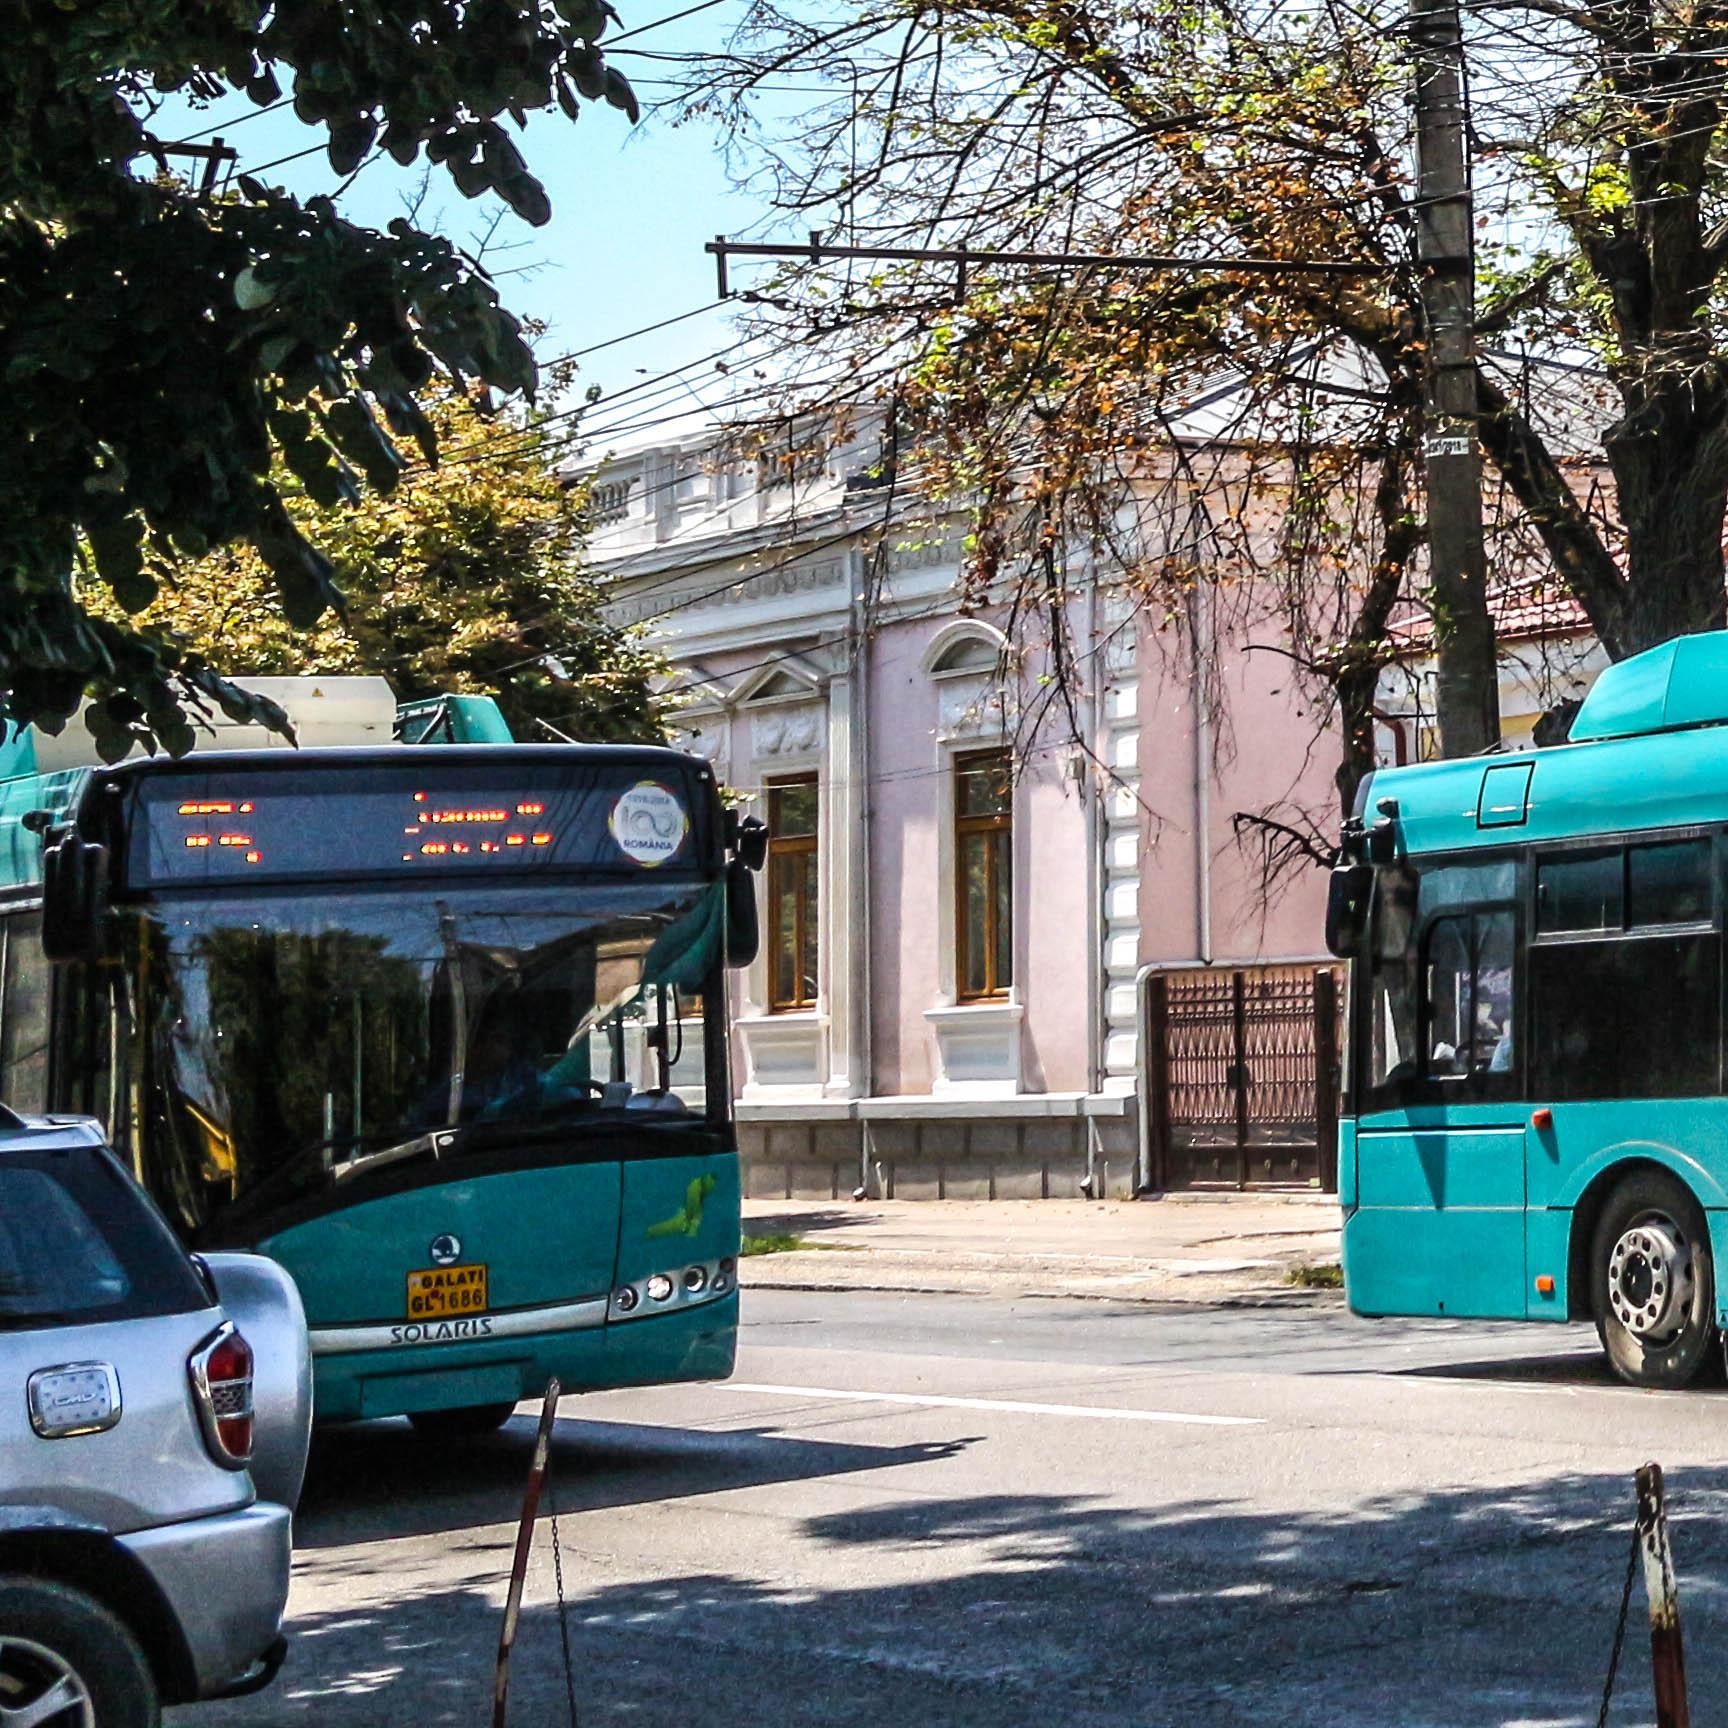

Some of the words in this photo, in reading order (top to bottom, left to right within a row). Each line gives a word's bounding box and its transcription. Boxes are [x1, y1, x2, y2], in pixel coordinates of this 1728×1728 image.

[623, 838, 674, 851] ROMÂNIA
[422, 1269, 484, 1289] GALATI
[391, 1318, 492, 1344] SOLARIS
